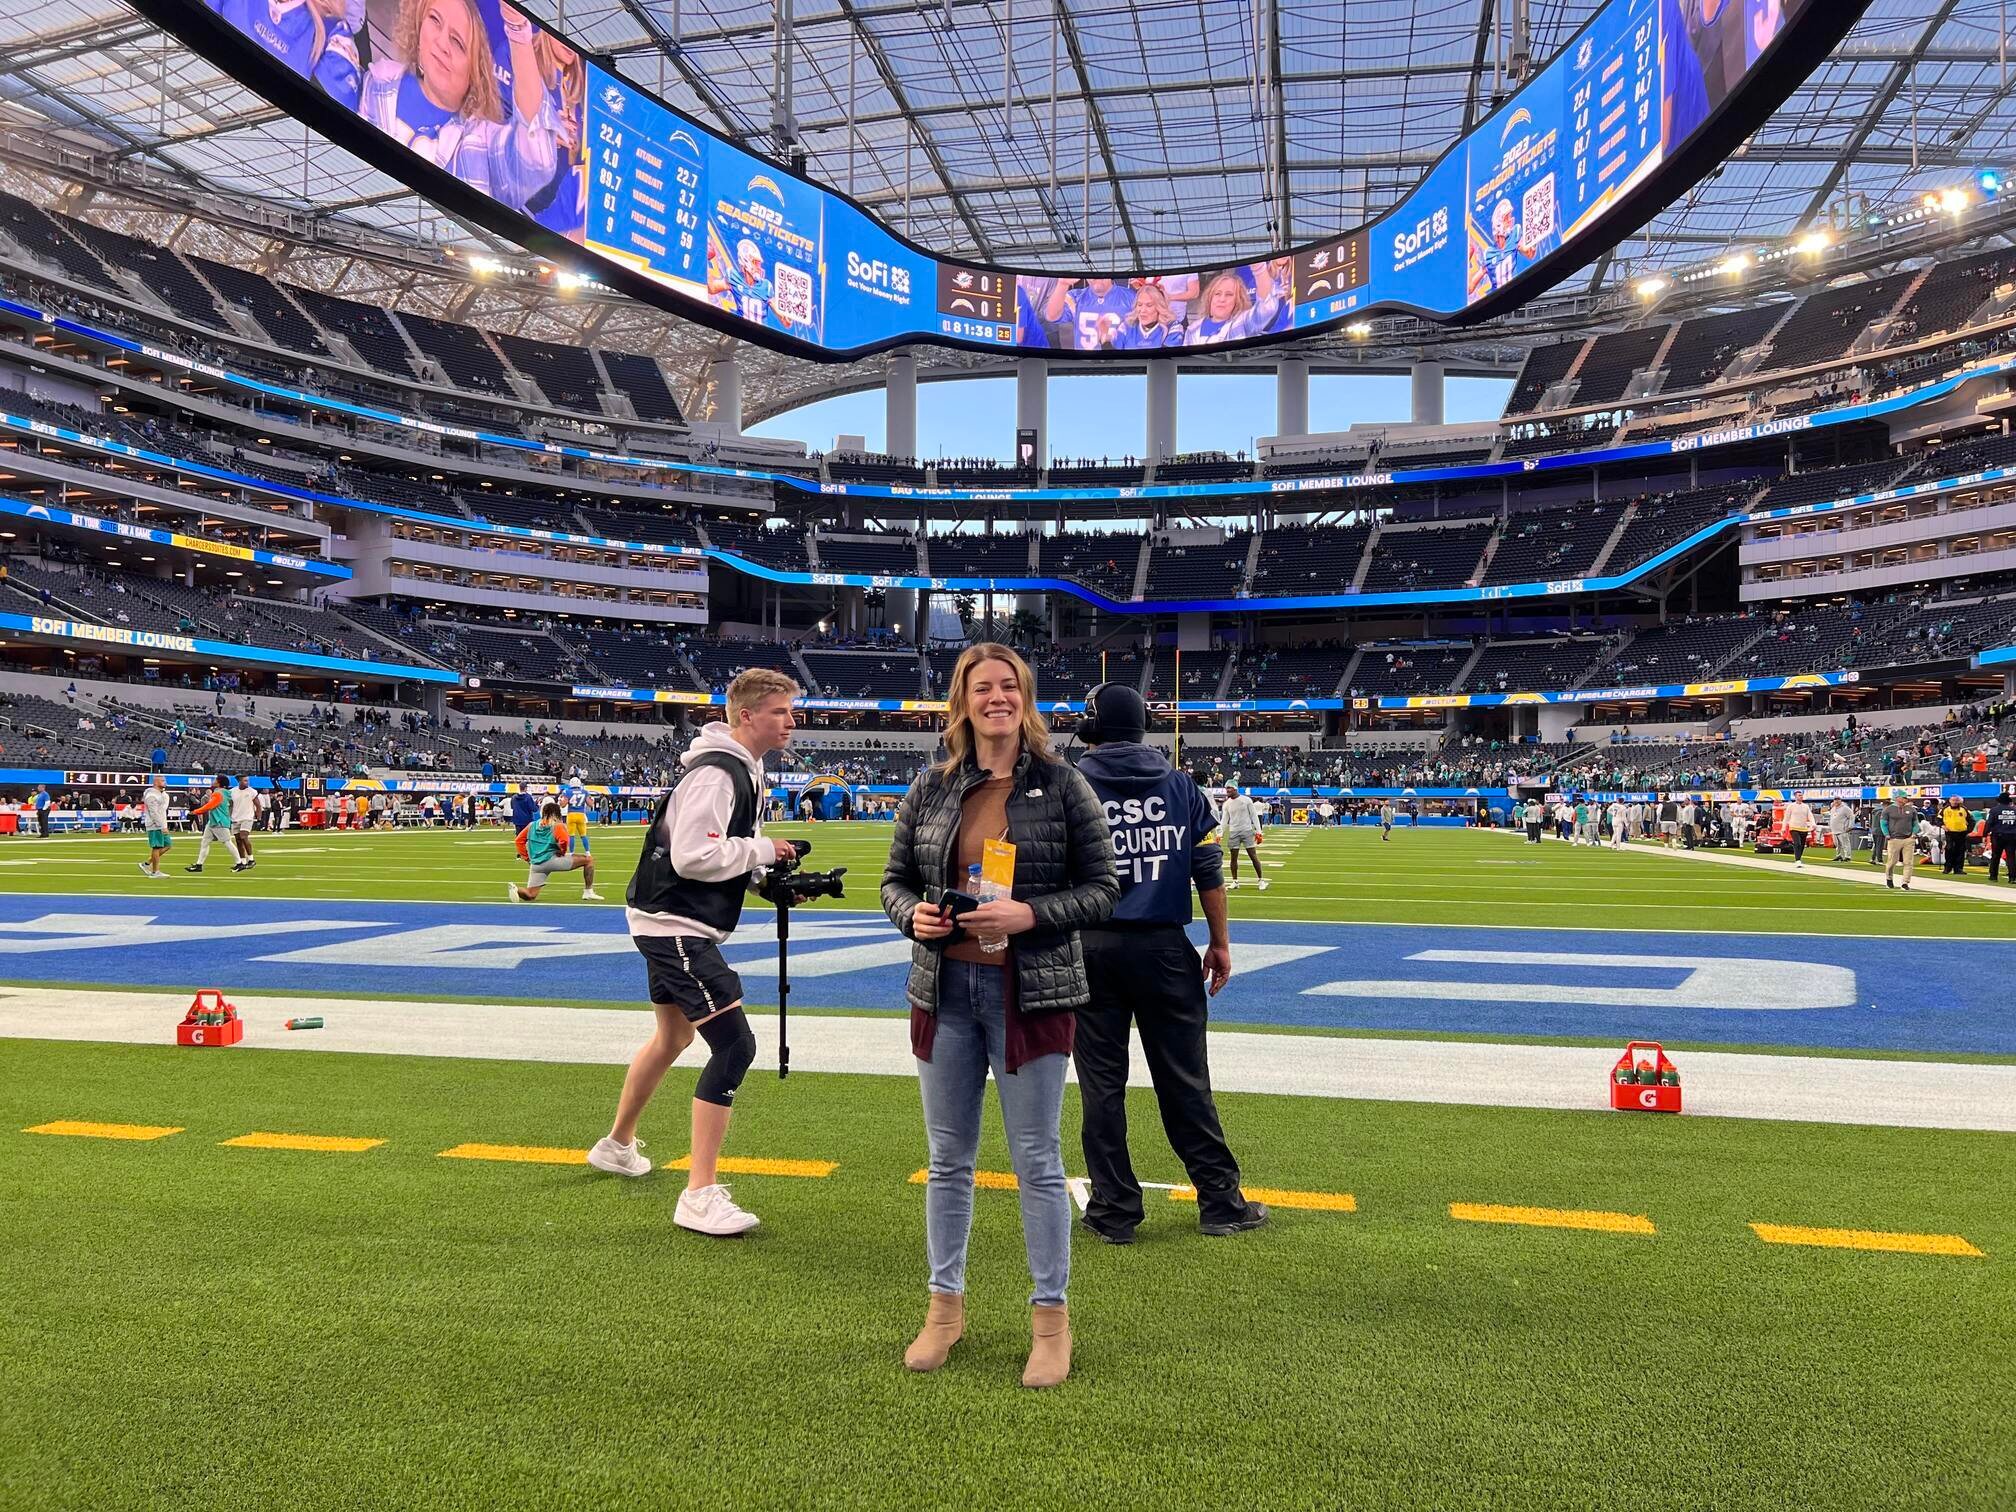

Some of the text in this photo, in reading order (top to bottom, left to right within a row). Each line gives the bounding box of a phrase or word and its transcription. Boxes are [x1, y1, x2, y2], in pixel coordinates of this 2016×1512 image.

[1635, 17, 1653, 52] 22.7
[1573, 81, 1592, 113] 22.4
[1576, 108, 1589, 133] 4.0
[600, 123, 622, 148] 22.4
[602, 148, 619, 168] 4.0
[1502, 135, 1530, 169] 2023
[1475, 165, 1515, 202] SEASON
[1516, 128, 1557, 171] TICKETS
[1577, 157, 1586, 181] 61
[600, 167, 622, 191] 89.7
[676, 166, 698, 188] 22.7
[603, 192, 616, 212] 61
[679, 189, 696, 208] 3.7
[676, 208, 698, 230] 84.7
[749, 200, 783, 225] 2023
[606, 216, 614, 233] 9
[717, 199, 814, 251] SEASON TICKETS
[680, 231, 693, 249] 59
[1394, 218, 1430, 259] SoFi
[682, 254, 690, 269] 8
[1337, 246, 1344, 262] 0
[847, 251, 888, 288] SoFi
[981, 275, 989, 292] 0
[1337, 272, 1344, 289] 0
[847, 278, 910, 305] Get Your Money Right
[981, 301, 989, 317] 0
[998, 330, 1010, 338] 25
[161, 351, 193, 369] MEMBER
[1671, 438, 1698, 452] SOFI
[1701, 427, 1752, 447] MEMBER
[820, 484, 838, 493] SoFi
[1271, 482, 1295, 491] SOFI
[1299, 478, 1343, 490] MEMBER
[71, 514, 84, 526] GET
[84, 516, 100, 529] YOUR
[117, 522, 129, 535] FOR
[129, 525, 135, 536] A
[135, 526, 151, 540] GAME
[185, 537, 241, 557] CHARGERSSUITES.COM
[812, 574, 832, 584] SoFi
[872, 576, 891, 587] SoFi
[1547, 580, 1571, 593] SoFi
[32, 616, 197, 651] SOFI MEMBER LOUNGE.
[591, 688, 632, 697] CHARGERS
[1575, 691, 1612, 700] ANGELES
[1612, 688, 1657, 698] CHARGERS
[308, 780, 318, 788] 25
[397, 781, 490, 791] LOS ANGELES CHARGERS
[1829, 788, 1862, 798] CHARGERS
[569, 793, 586, 807] 47
[301, 814, 308, 823] G
[1102, 796, 1166, 826] CSC
[1111, 825, 1186, 855] CURITY
[191, 1029, 204, 1044] G
[1639, 1089, 1657, 1108] G
